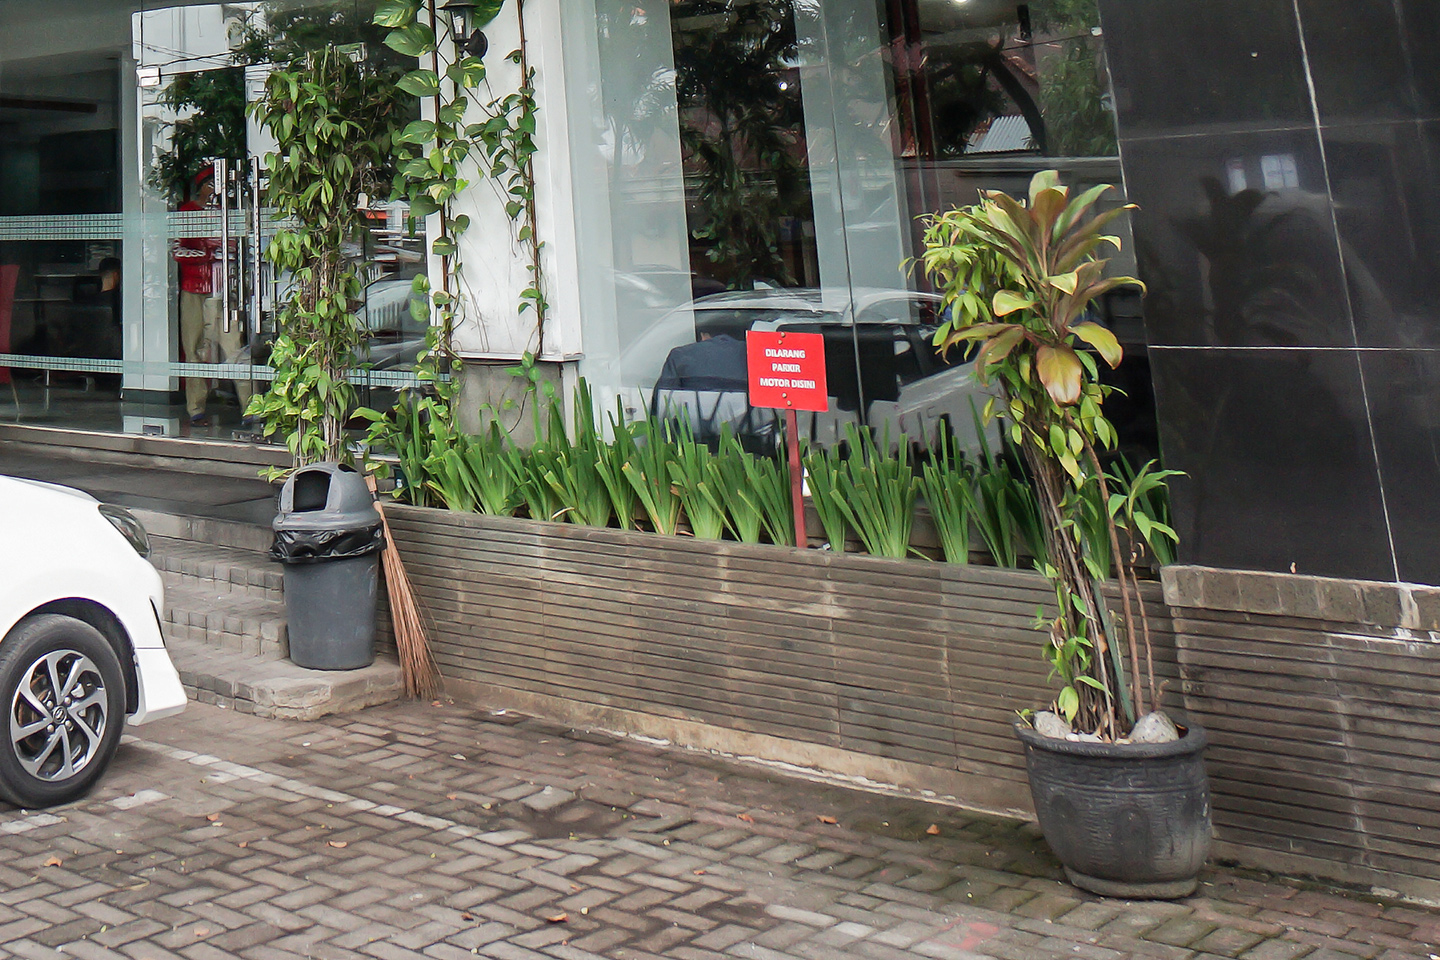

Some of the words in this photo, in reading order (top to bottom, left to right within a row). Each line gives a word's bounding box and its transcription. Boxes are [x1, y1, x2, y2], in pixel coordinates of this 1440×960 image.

[765, 348, 806, 359] DILARANG
[772, 363, 801, 373] PARKIR
[760, 378, 790, 388] MOTOR
[791, 380, 816, 389] DISINI
